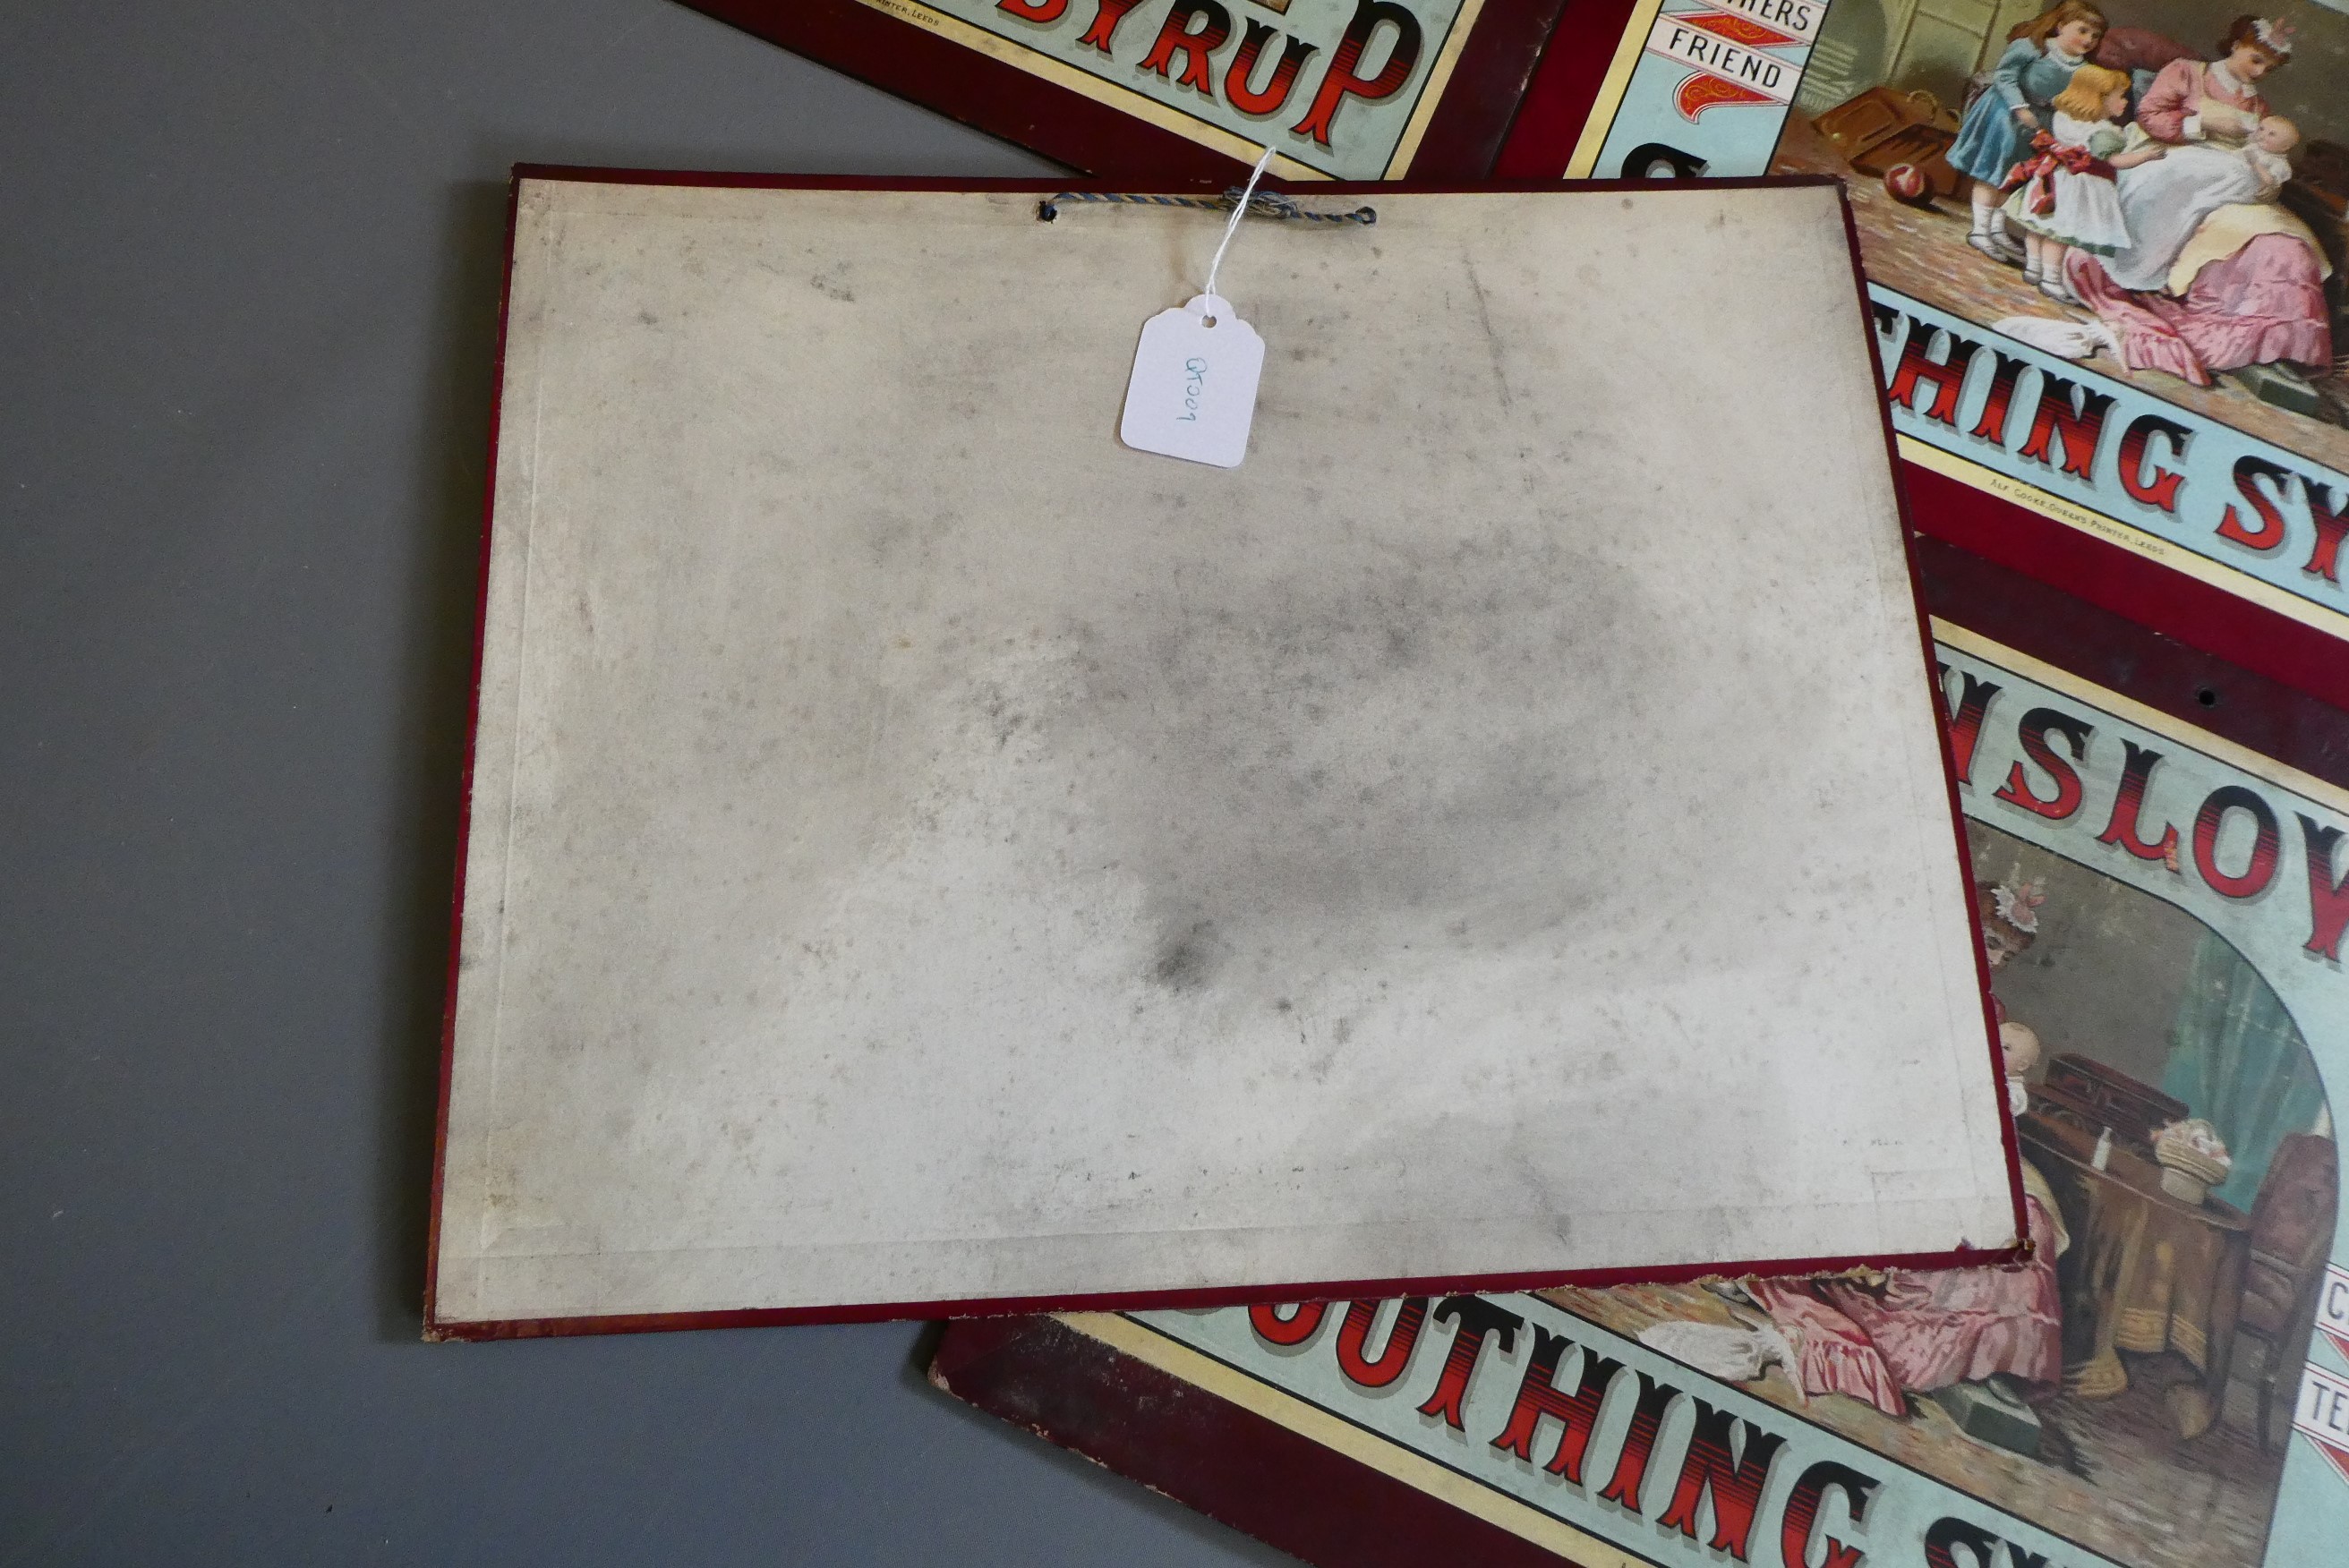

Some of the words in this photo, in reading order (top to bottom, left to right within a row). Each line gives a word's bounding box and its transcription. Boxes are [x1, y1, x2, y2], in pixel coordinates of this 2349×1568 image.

[912, 10, 939, 26] LEEDS
[1727, 0, 1811, 31] ERS
[995, 0, 1423, 149] YRUP
[1669, 28, 1781, 89] FRIEND
